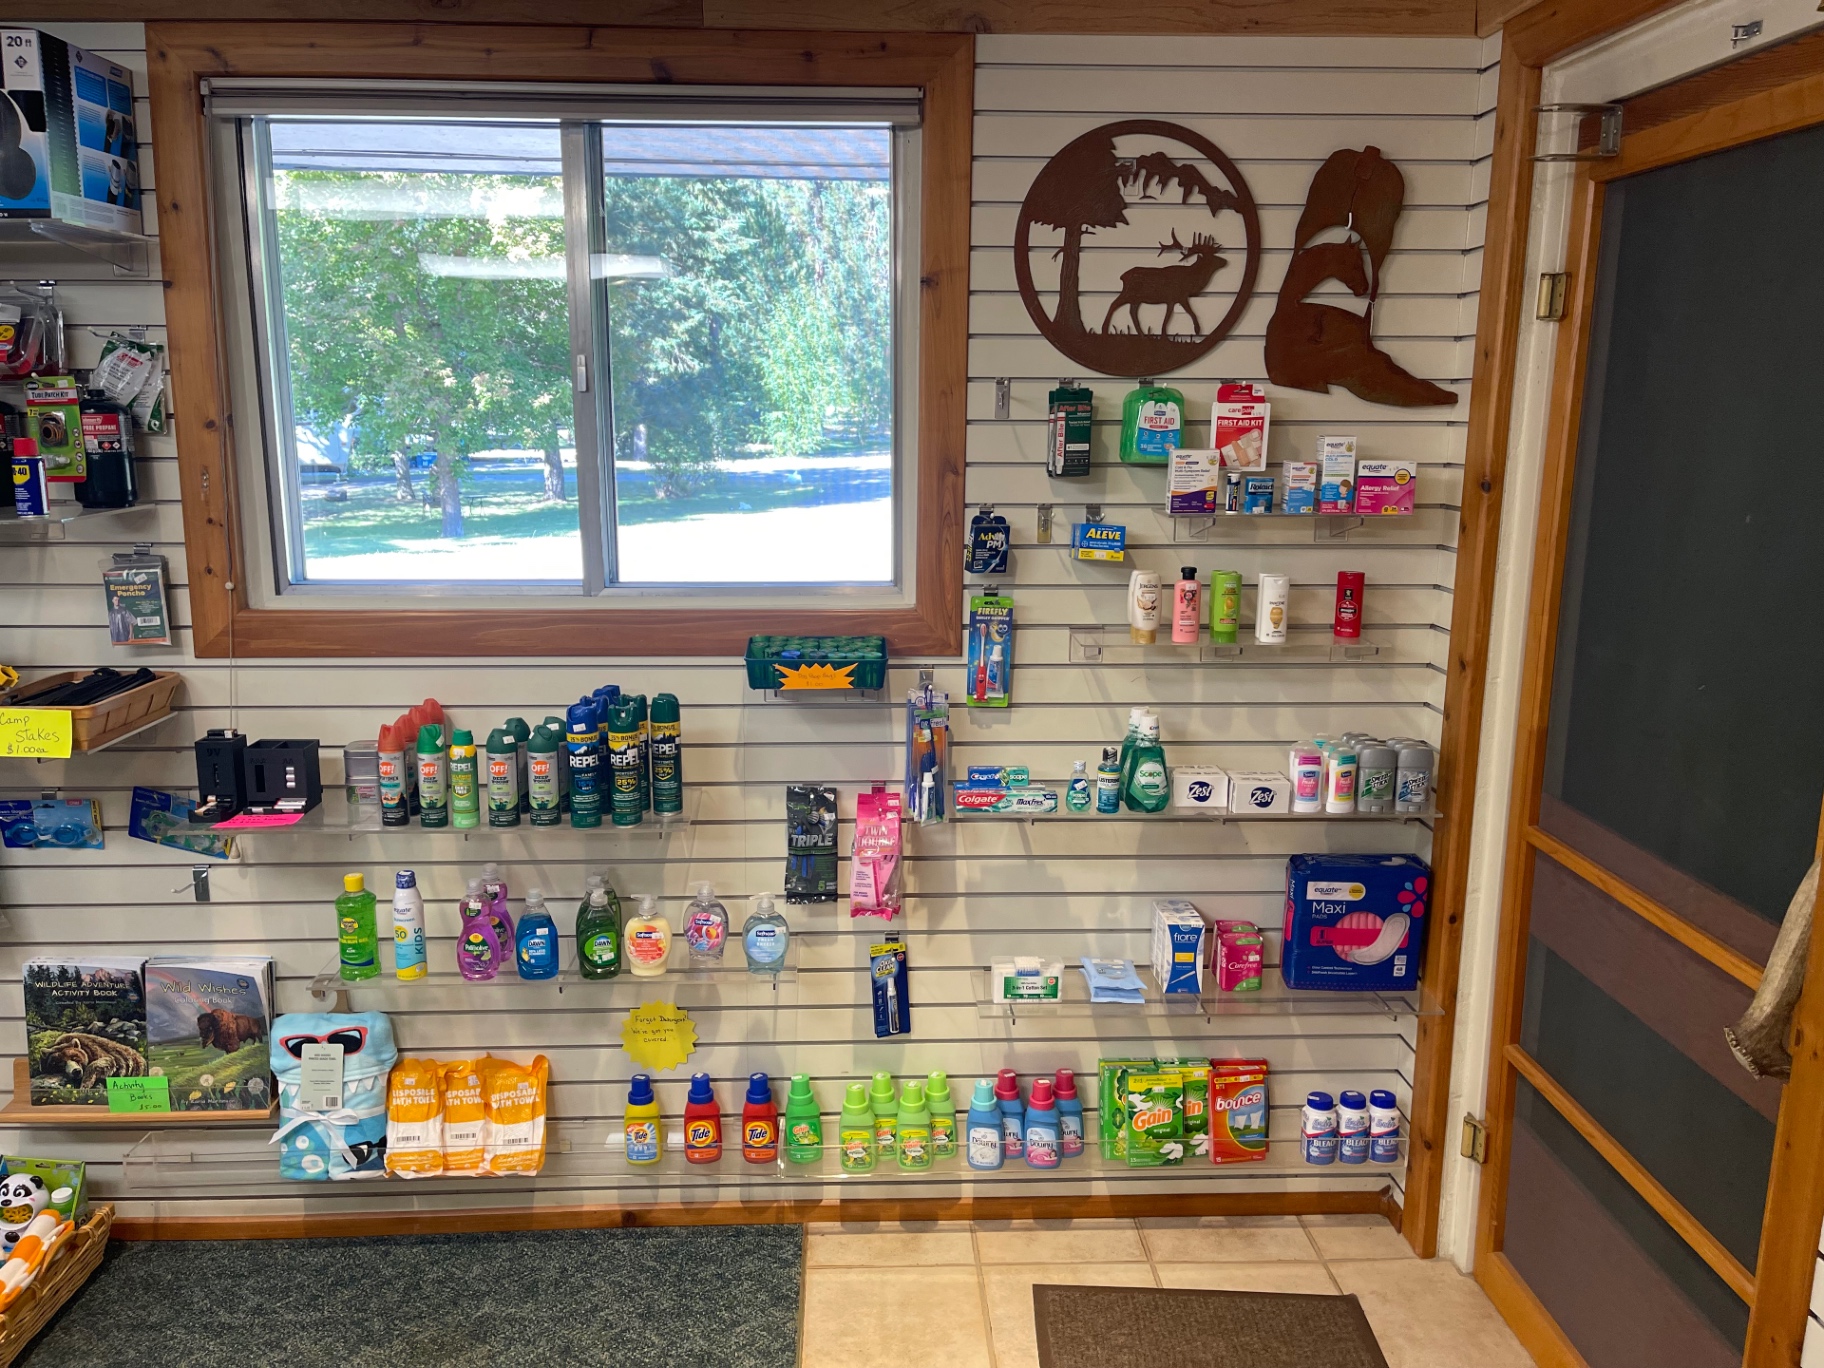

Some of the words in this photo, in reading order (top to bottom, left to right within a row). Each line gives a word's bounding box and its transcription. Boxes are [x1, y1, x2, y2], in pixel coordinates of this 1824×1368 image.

[6, 36, 23, 47] 20
[25, 38, 32, 47] ft
[1144, 416, 1162, 424] FIRST
[1164, 417, 1174, 425] AID
[1362, 464, 1387, 472] equate
[1085, 527, 1121, 540] ALEVE
[986, 540, 1001, 549] PM
[110, 584, 151, 592] Emergency
[977, 607, 1008, 615] FIREFLY
[0, 712, 30, 726] Camp
[16, 728, 60, 743] Stakes
[569, 754, 599, 768] REPEL
[610, 753, 639, 766] REPEL
[379, 764, 395, 774] OFF!
[420, 765, 438, 774] OFF!
[489, 764, 508, 773] OFF!
[532, 764, 550, 773] OFF!
[1139, 770, 1162, 780] Scope
[616, 778, 636, 786] 25%
[1188, 783, 1213, 800] Zest
[1250, 788, 1277, 805] Zest
[959, 795, 998, 804] Colgate
[864, 826, 889, 836] TWIN
[791, 833, 834, 847] TRIPLE
[818, 880, 826, 891] 5
[1314, 887, 1339, 895] equate
[1312, 901, 1346, 914] Maxi
[394, 930, 407, 939] 50
[1173, 933, 1197, 942] fiore
[413, 927, 424, 955] KIDS
[876, 964, 894, 973] CLEAN
[1228, 962, 1258, 970] Carefree
[81, 981, 130, 989] ADVENTURE
[160, 980, 191, 994] Wild
[198, 981, 247, 996] Wishes
[113, 1080, 145, 1093] Activity
[130, 1093, 153, 1102] Books
[1216, 1093, 1261, 1111] bounce
[1132, 1109, 1173, 1132] Gain
[690, 1127, 711, 1142] Tide
[748, 1127, 767, 1142] Tide
[793, 1125, 808, 1134] Gain
[633, 1130, 648, 1142] Tide
[972, 1136, 997, 1149] Downy
[1029, 1138, 1053, 1149] Downy
